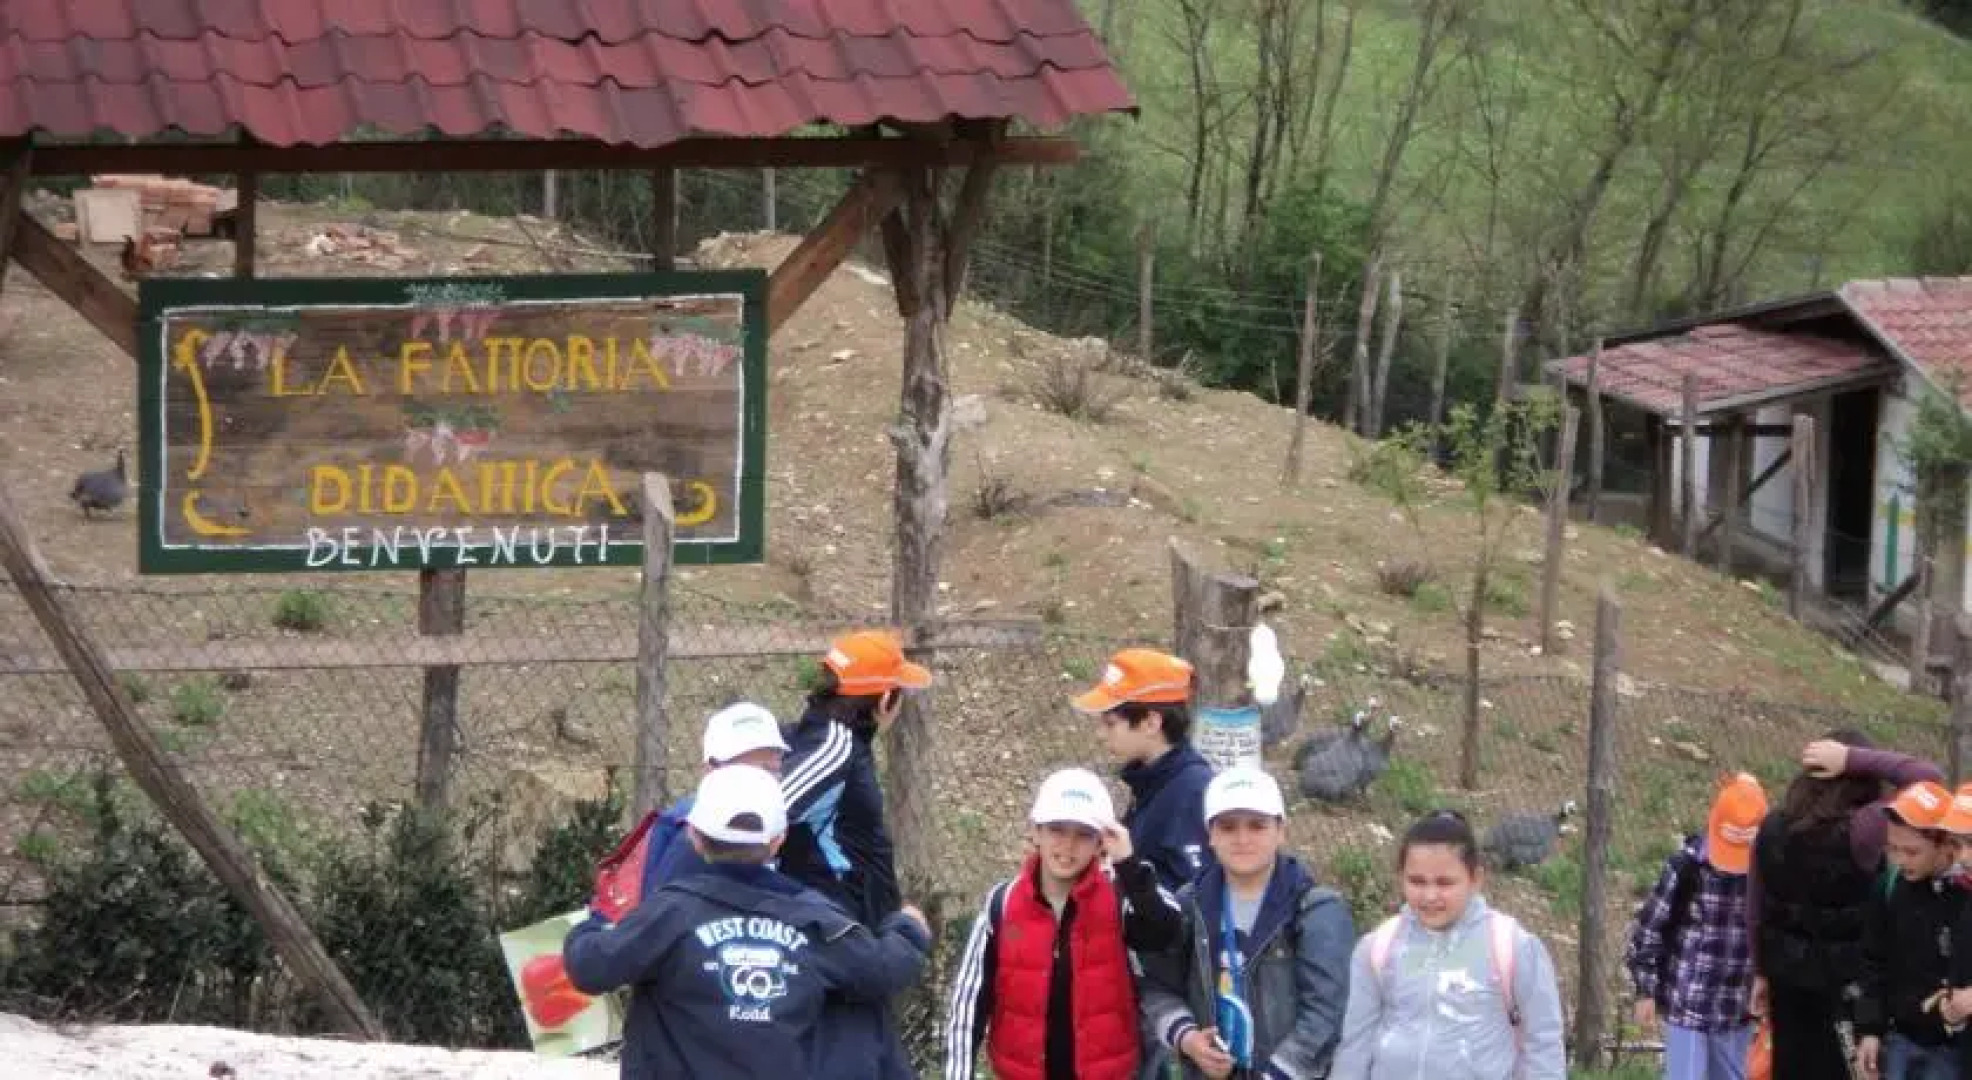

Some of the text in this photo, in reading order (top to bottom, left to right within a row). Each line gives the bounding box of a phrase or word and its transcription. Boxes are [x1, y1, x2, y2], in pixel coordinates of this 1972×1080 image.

[269, 333, 672, 396] LA FATTORIA
[309, 457, 629, 516] DIDATTICA
[305, 525, 609, 567] BENVENUTI
[695, 917, 808, 951] WEST COAST
